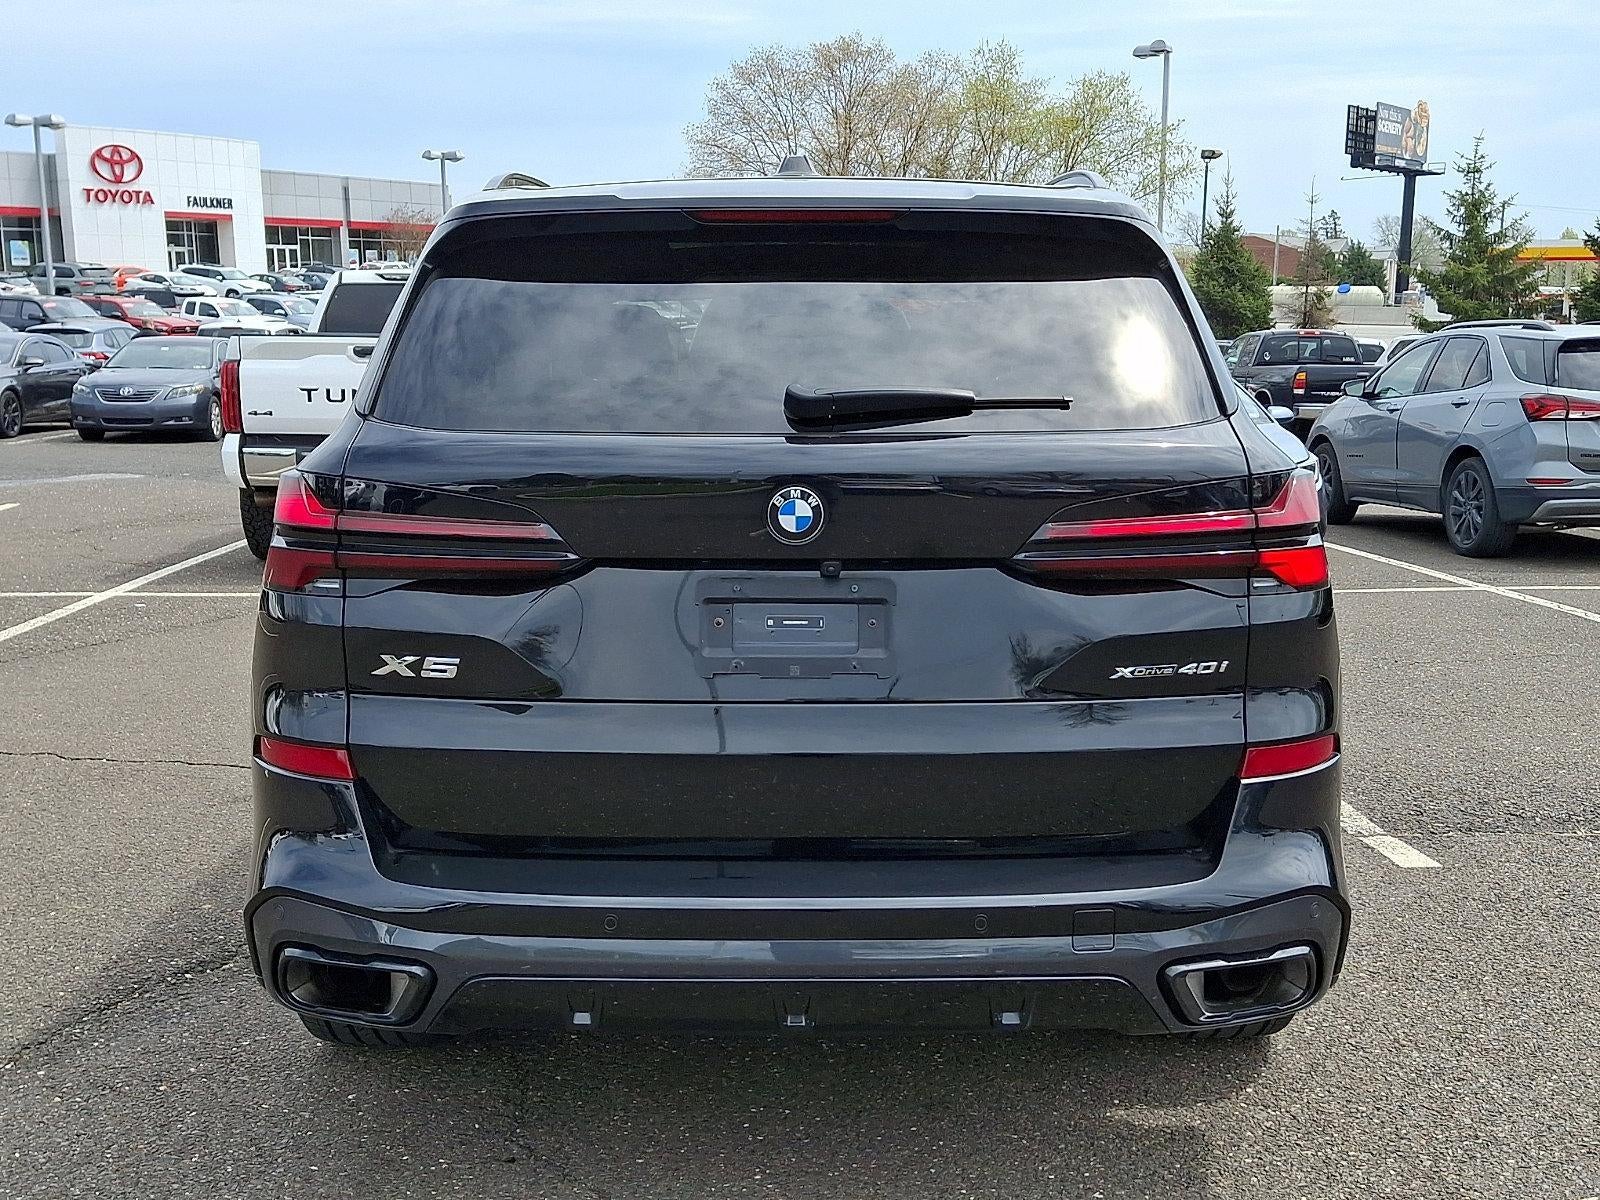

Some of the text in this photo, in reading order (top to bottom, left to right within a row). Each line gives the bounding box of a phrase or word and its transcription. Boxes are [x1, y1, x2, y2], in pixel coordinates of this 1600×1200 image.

[83, 188, 155, 205] TOYOTA
[187, 196, 233, 209] FAULKNER
[773, 489, 819, 508] BMW
[371, 654, 461, 679] X5
